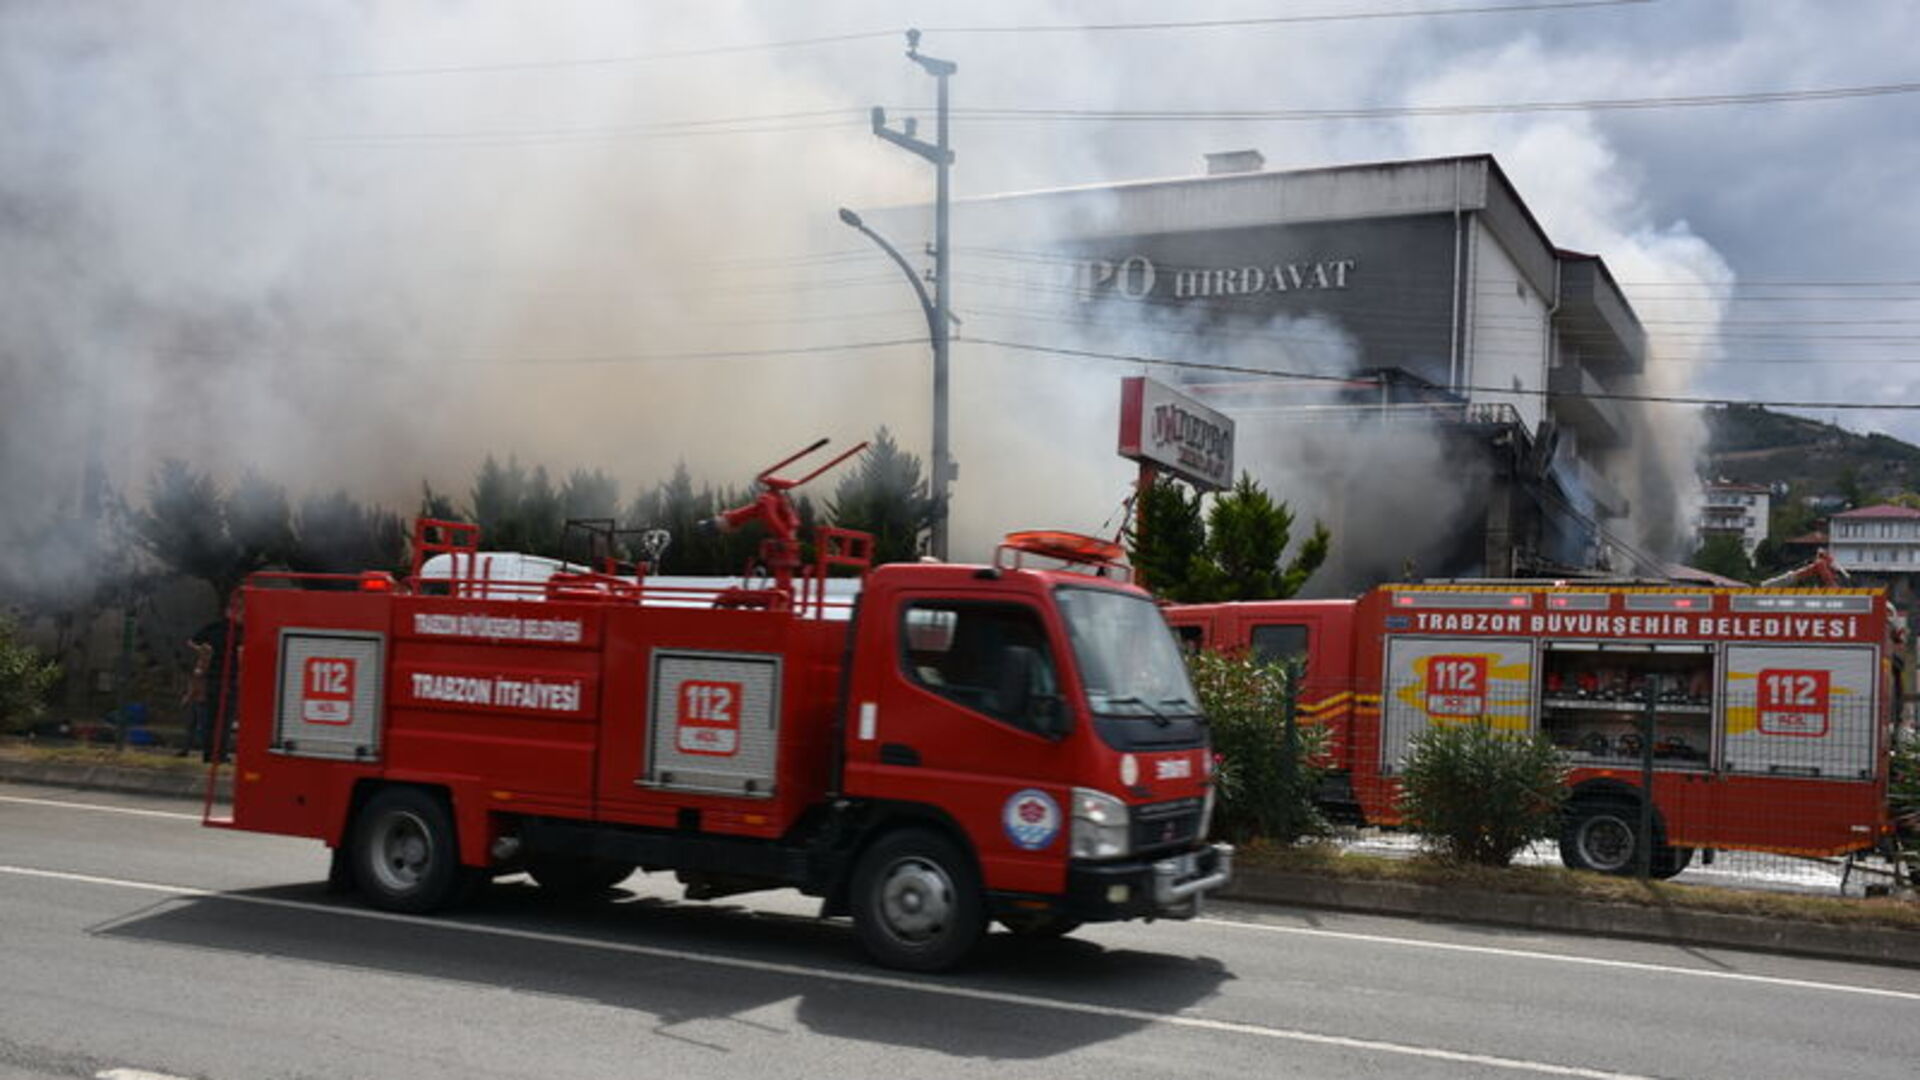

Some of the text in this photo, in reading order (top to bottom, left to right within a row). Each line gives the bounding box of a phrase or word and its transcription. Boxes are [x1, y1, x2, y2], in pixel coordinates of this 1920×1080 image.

[1175, 260, 1354, 298] HIRDAVAT
[1417, 613, 1521, 632] TRABZON
[1531, 613, 1689, 636] BÜYÜKŞEHİR
[1699, 615, 1857, 638] BELEDİYESİ
[309, 661, 347, 693] 112
[412, 673, 581, 711] TRABZON İTFAİYESİ
[1435, 661, 1477, 691] 112
[1766, 674, 1818, 706] 112
[685, 685, 732, 722] 112
